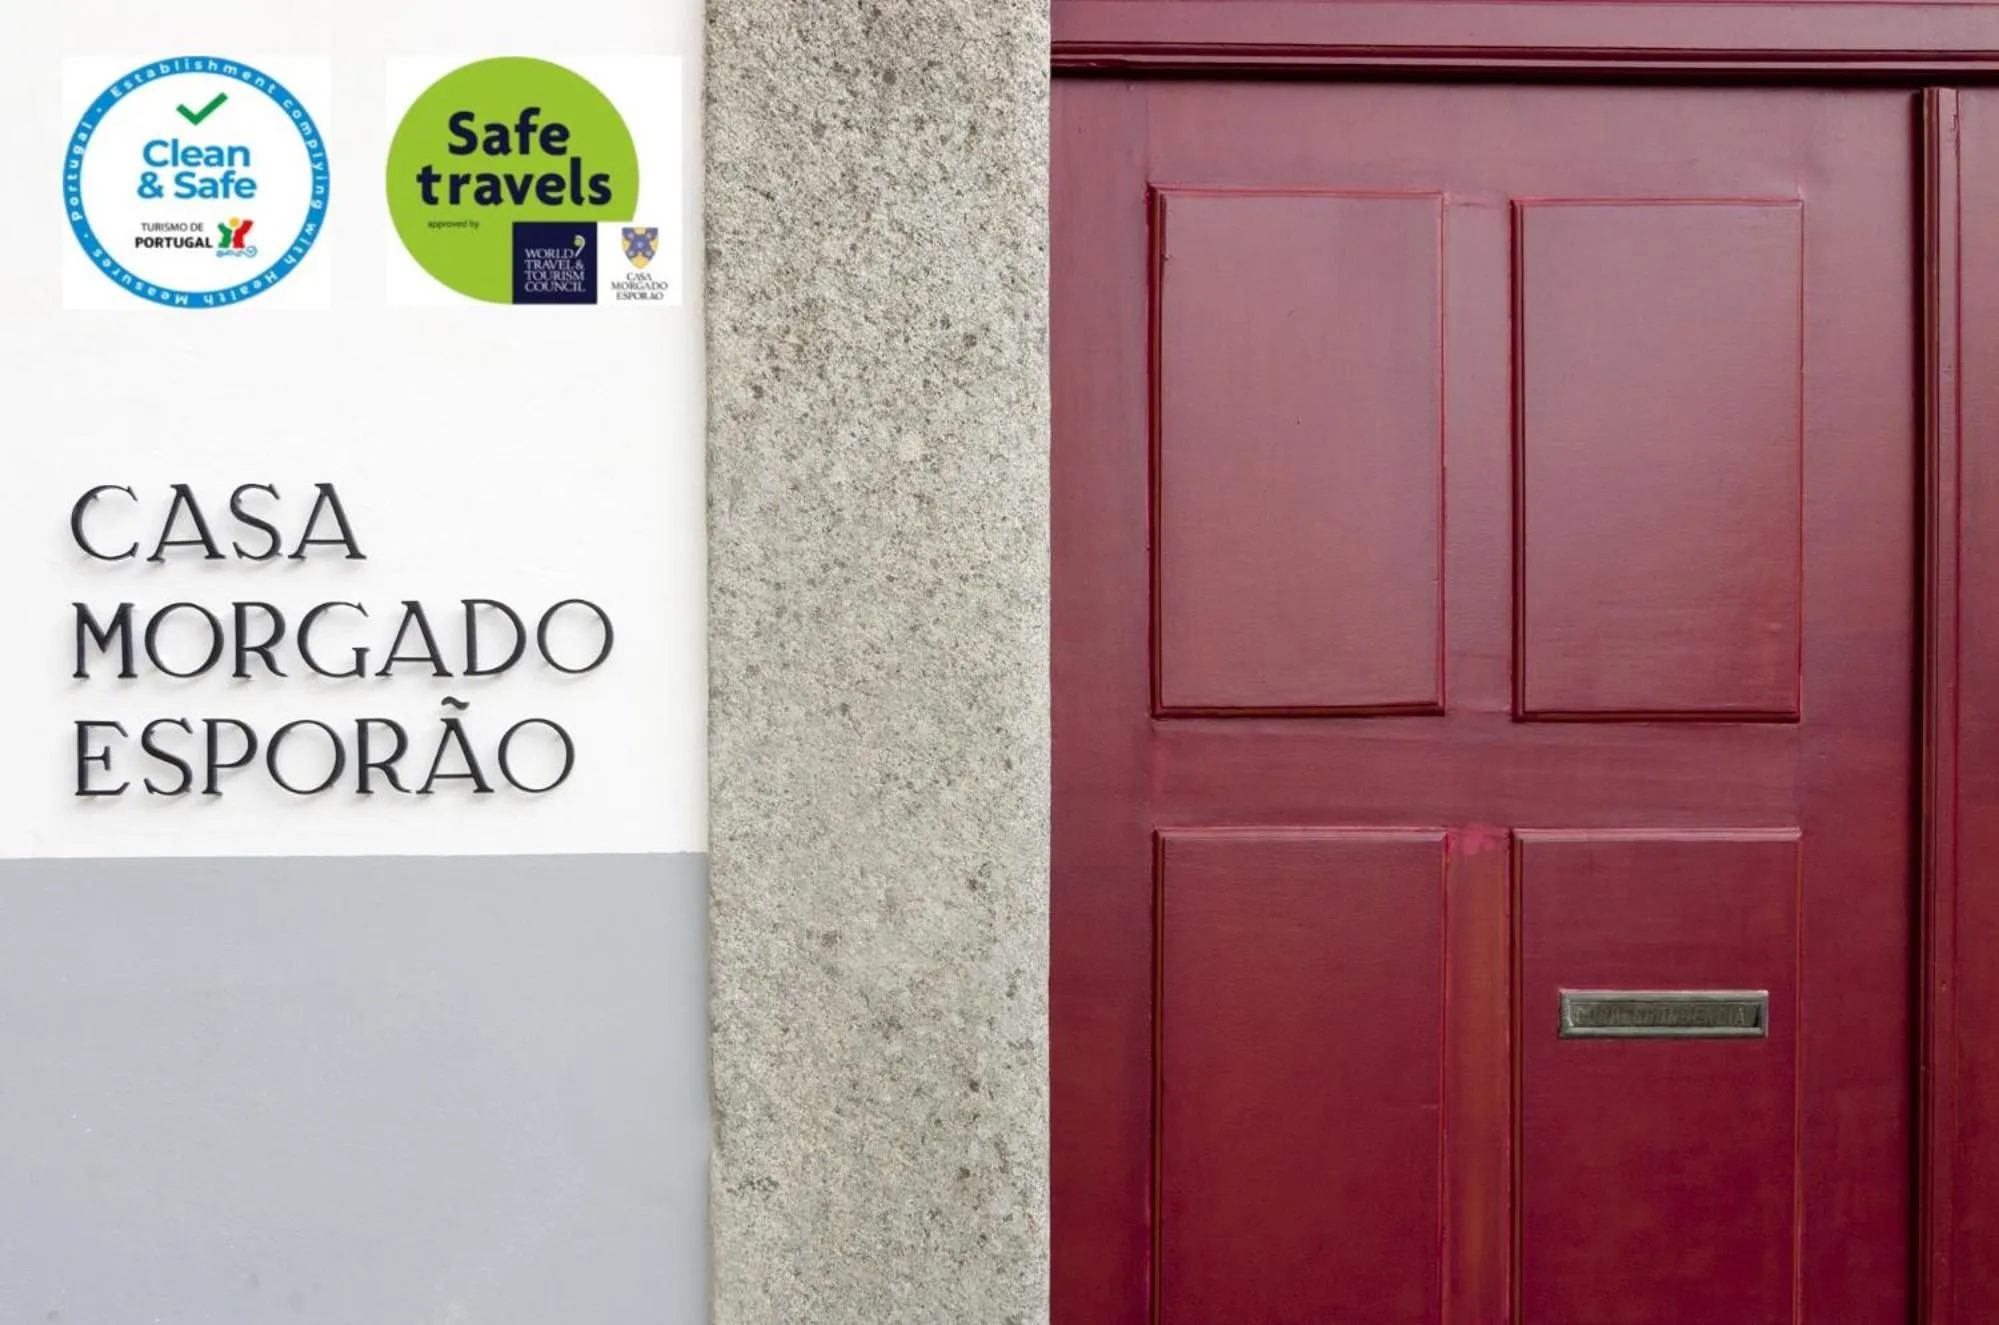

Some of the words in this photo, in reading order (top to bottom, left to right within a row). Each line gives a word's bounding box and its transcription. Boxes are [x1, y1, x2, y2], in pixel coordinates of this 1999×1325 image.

[69, 482, 367, 562] CASA
[71, 598, 615, 679] MORGADO
[73, 695, 576, 796] ESPORÃO
